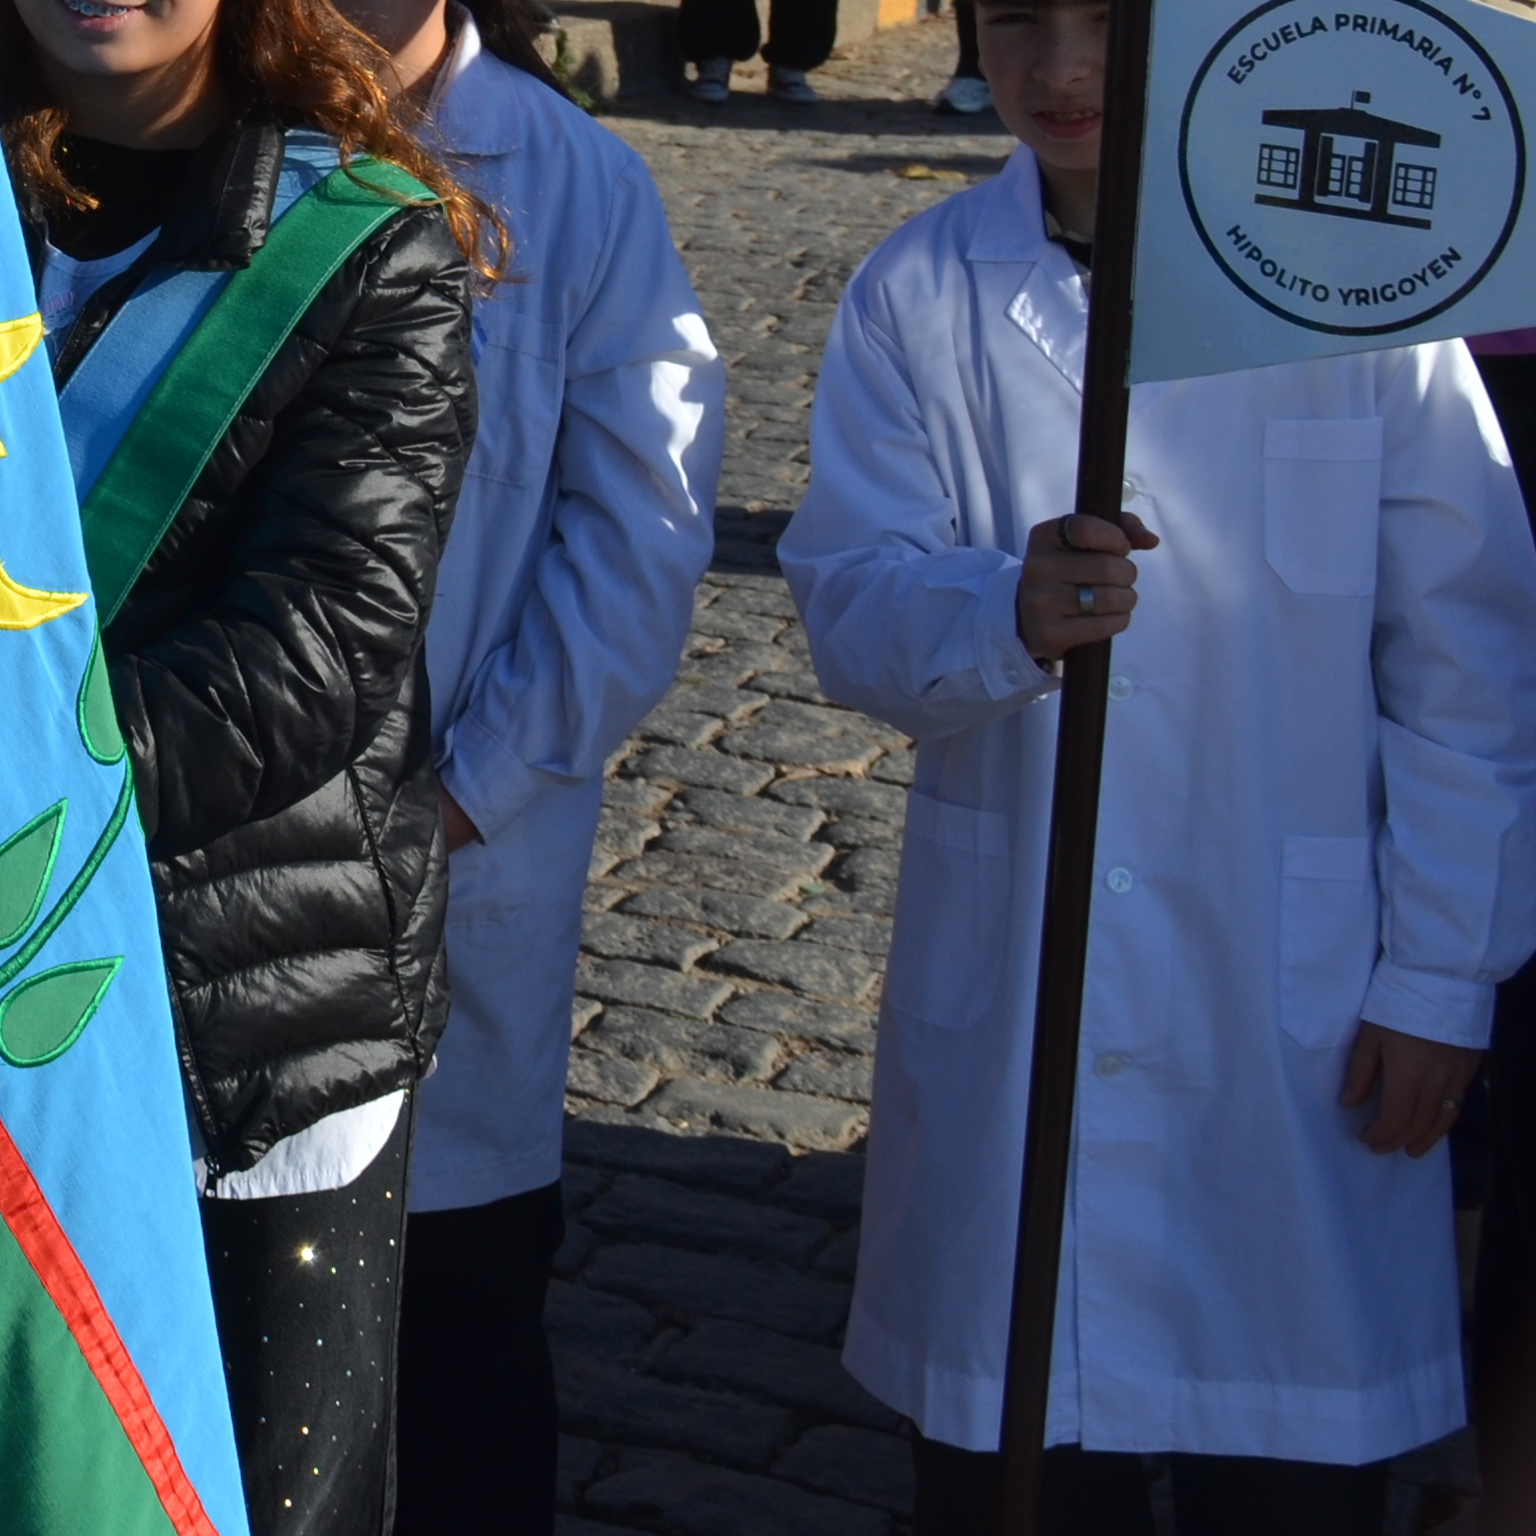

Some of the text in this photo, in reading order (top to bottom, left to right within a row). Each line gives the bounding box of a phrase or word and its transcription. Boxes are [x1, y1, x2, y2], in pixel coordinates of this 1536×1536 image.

[1227, 16, 1328, 85] ESCUELA
[1334, 13, 1454, 76] PRIMARIA
[1471, 106, 1492, 122] 7
[1226, 224, 1462, 306] HIPOLITO YRIGOYEN
